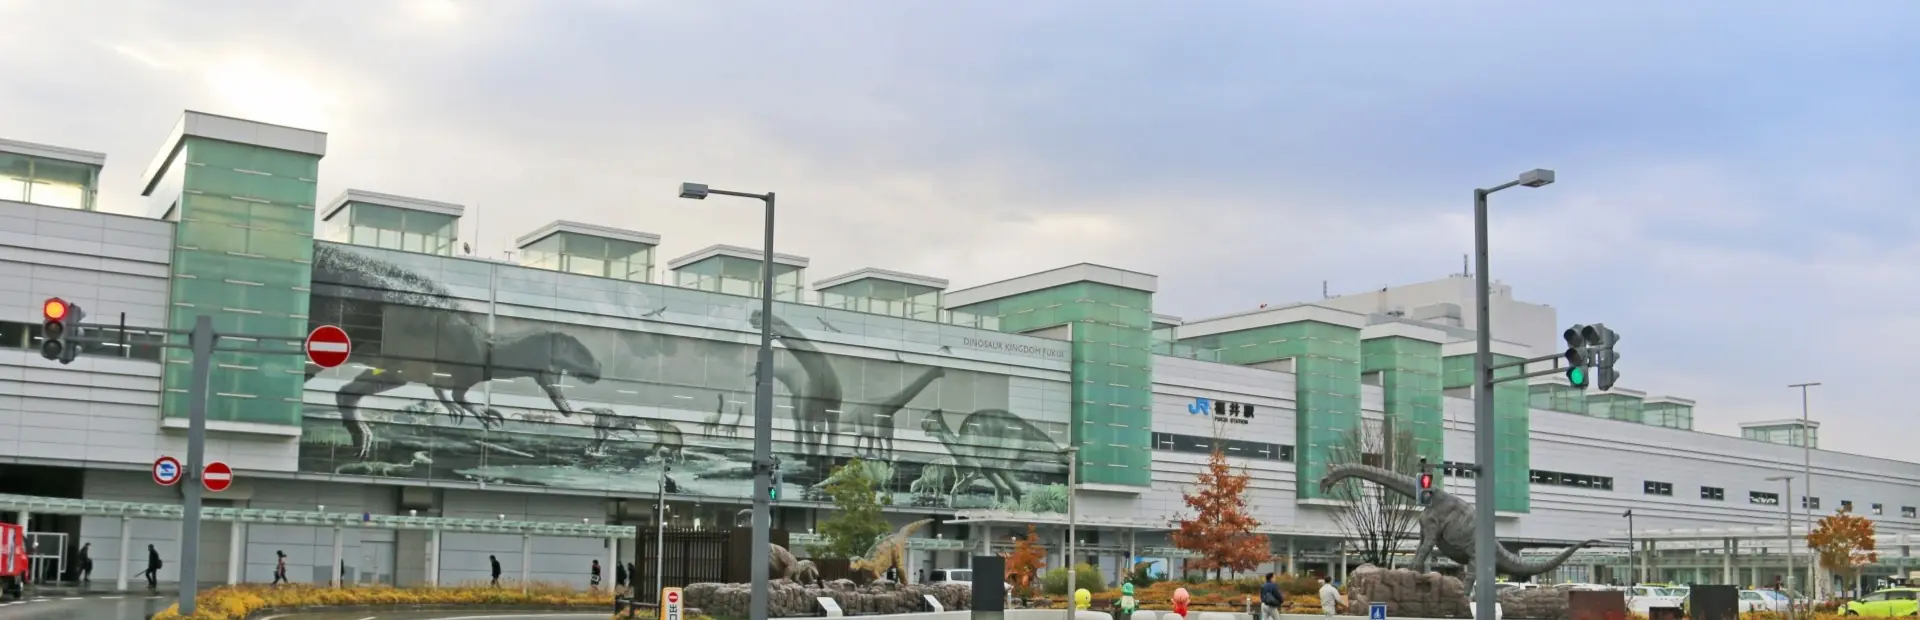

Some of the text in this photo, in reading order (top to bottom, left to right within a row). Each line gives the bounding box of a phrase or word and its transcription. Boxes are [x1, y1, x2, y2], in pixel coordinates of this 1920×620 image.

[963, 337, 1064, 358] DINOSAUR KINGDOM FUKUI
[1188, 397, 1210, 415] JR
